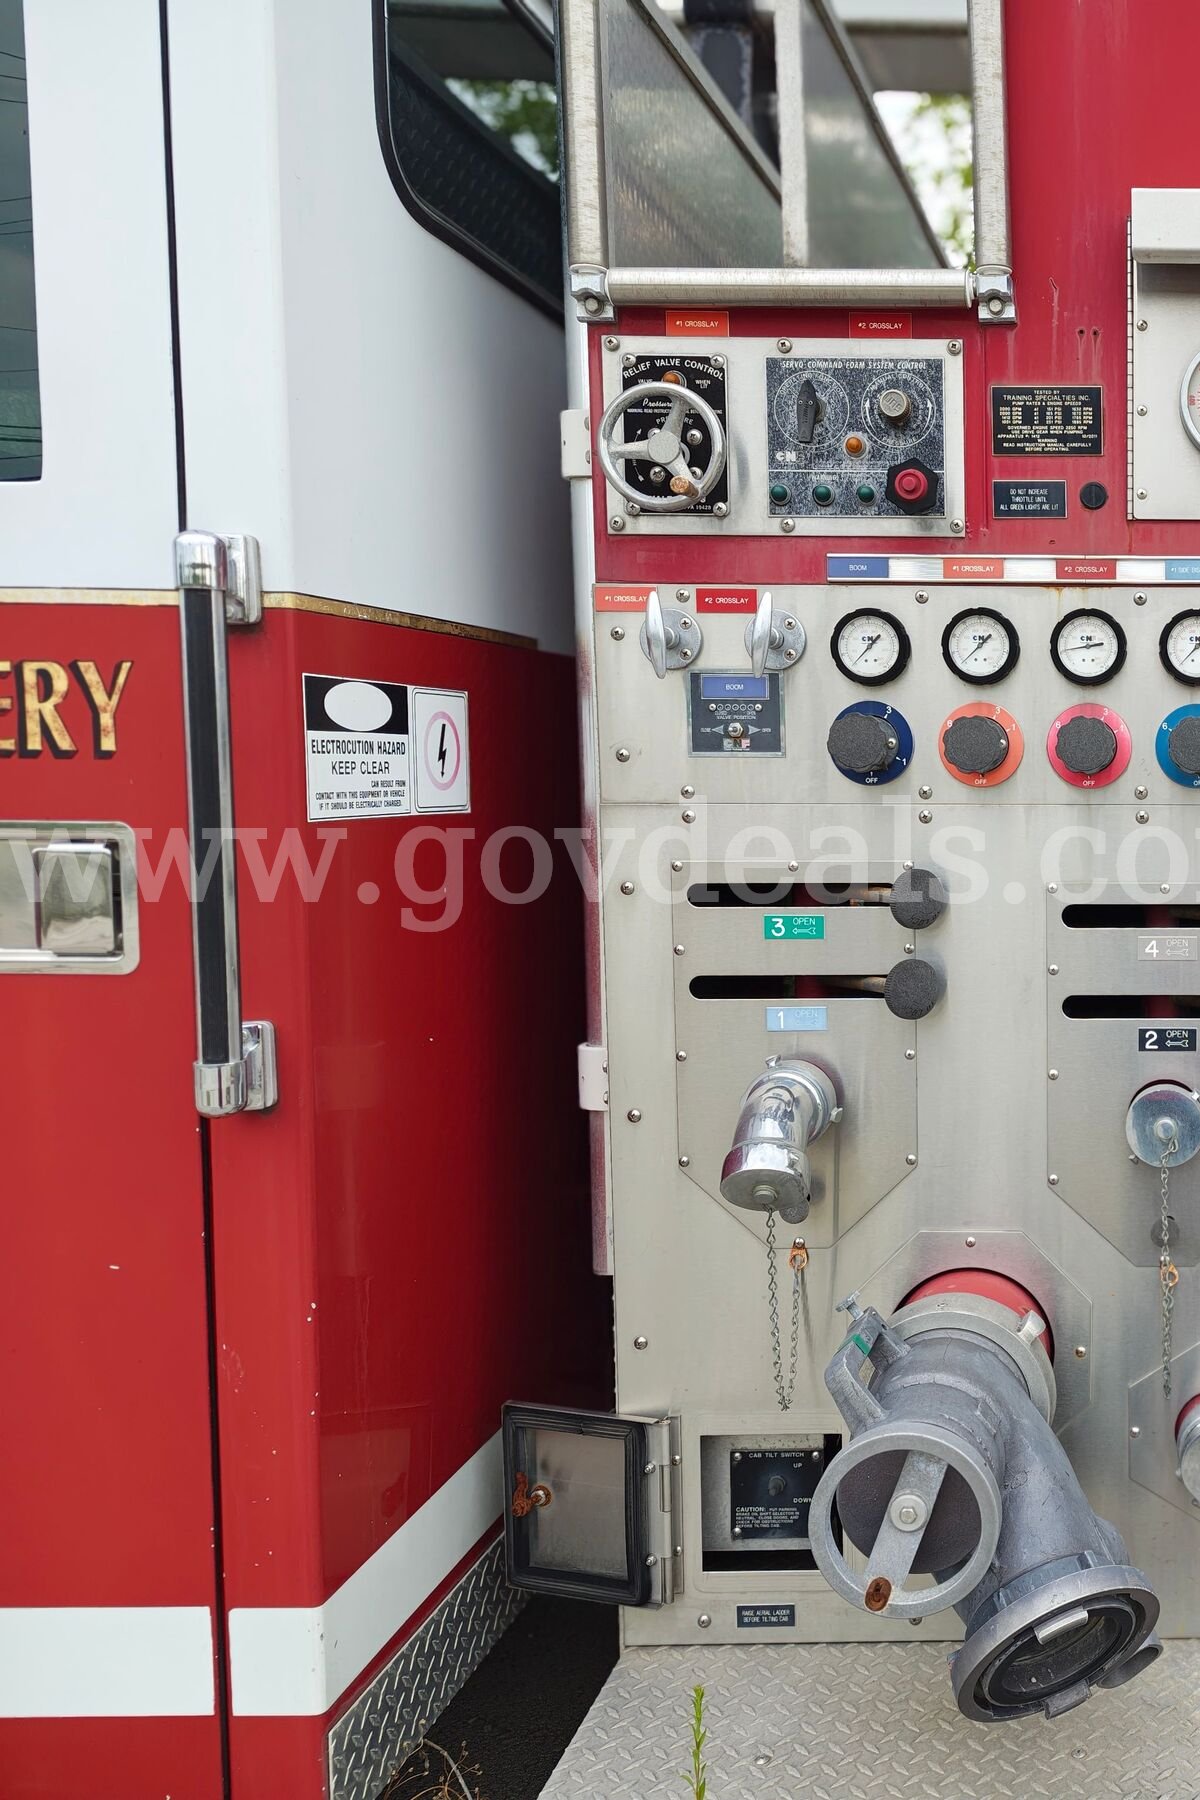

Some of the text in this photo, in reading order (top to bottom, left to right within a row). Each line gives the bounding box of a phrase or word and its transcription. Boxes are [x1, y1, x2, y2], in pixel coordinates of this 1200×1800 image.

[623, 362, 651, 379] RELIEF
[685, 360, 724, 380] CONTROL
[846, 361, 864, 369] FOAM
[868, 361, 894, 369] SYSTEM
[898, 361, 926, 369] CONTROL
[312, 740, 405, 755] ELECTROCUTION HAZARD
[331, 761, 390, 774] KEEP CLEAR
[316, 792, 334, 800] CONTACT
[324, 802, 329, 810] IT
[771, 918, 785, 937] 3
[1145, 940, 1159, 958] 4
[777, 1011, 785, 1029] 1
[1145, 1030, 1188, 1049] 2 OPEN
